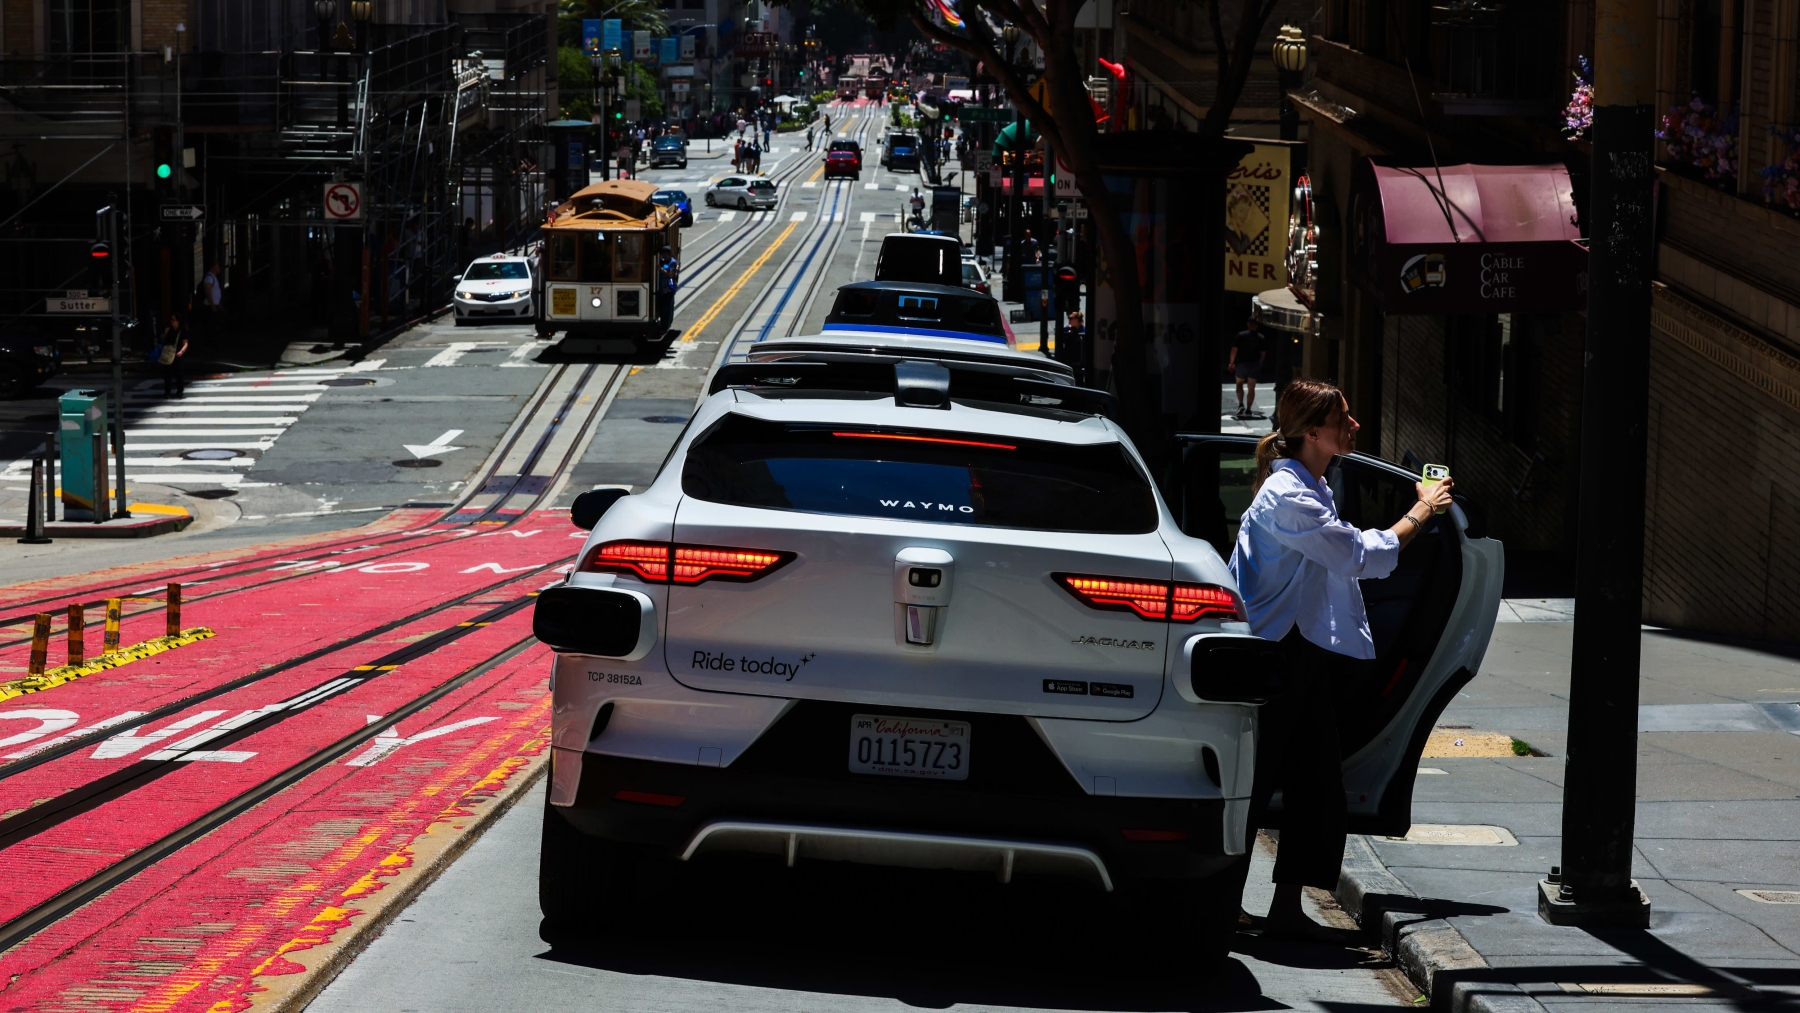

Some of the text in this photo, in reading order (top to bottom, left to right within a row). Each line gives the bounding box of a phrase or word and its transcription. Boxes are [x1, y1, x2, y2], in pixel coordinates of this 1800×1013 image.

[972, 111, 998, 119] Post
[978, 161, 991, 170] 20
[1057, 179, 1071, 190] ON
[1480, 253, 1524, 269] CABLE
[1229, 260, 1277, 280] NER
[1480, 268, 1509, 284] CAR
[590, 287, 603, 295] 17
[1480, 283, 1516, 298] CAFE
[60, 302, 96, 310] Sutter
[879, 500, 974, 513] WAYMO
[1071, 636, 1155, 650] JAGUAR
[692, 651, 800, 681] Ride today
[588, 671, 642, 686] TCP 38152A
[1103, 688, 1120, 696] Google
[857, 720, 872, 729] APR
[876, 720, 949, 738] California
[858, 736, 962, 770] 01157Z3
[878, 767, 939, 775] dmv.ca.gov
